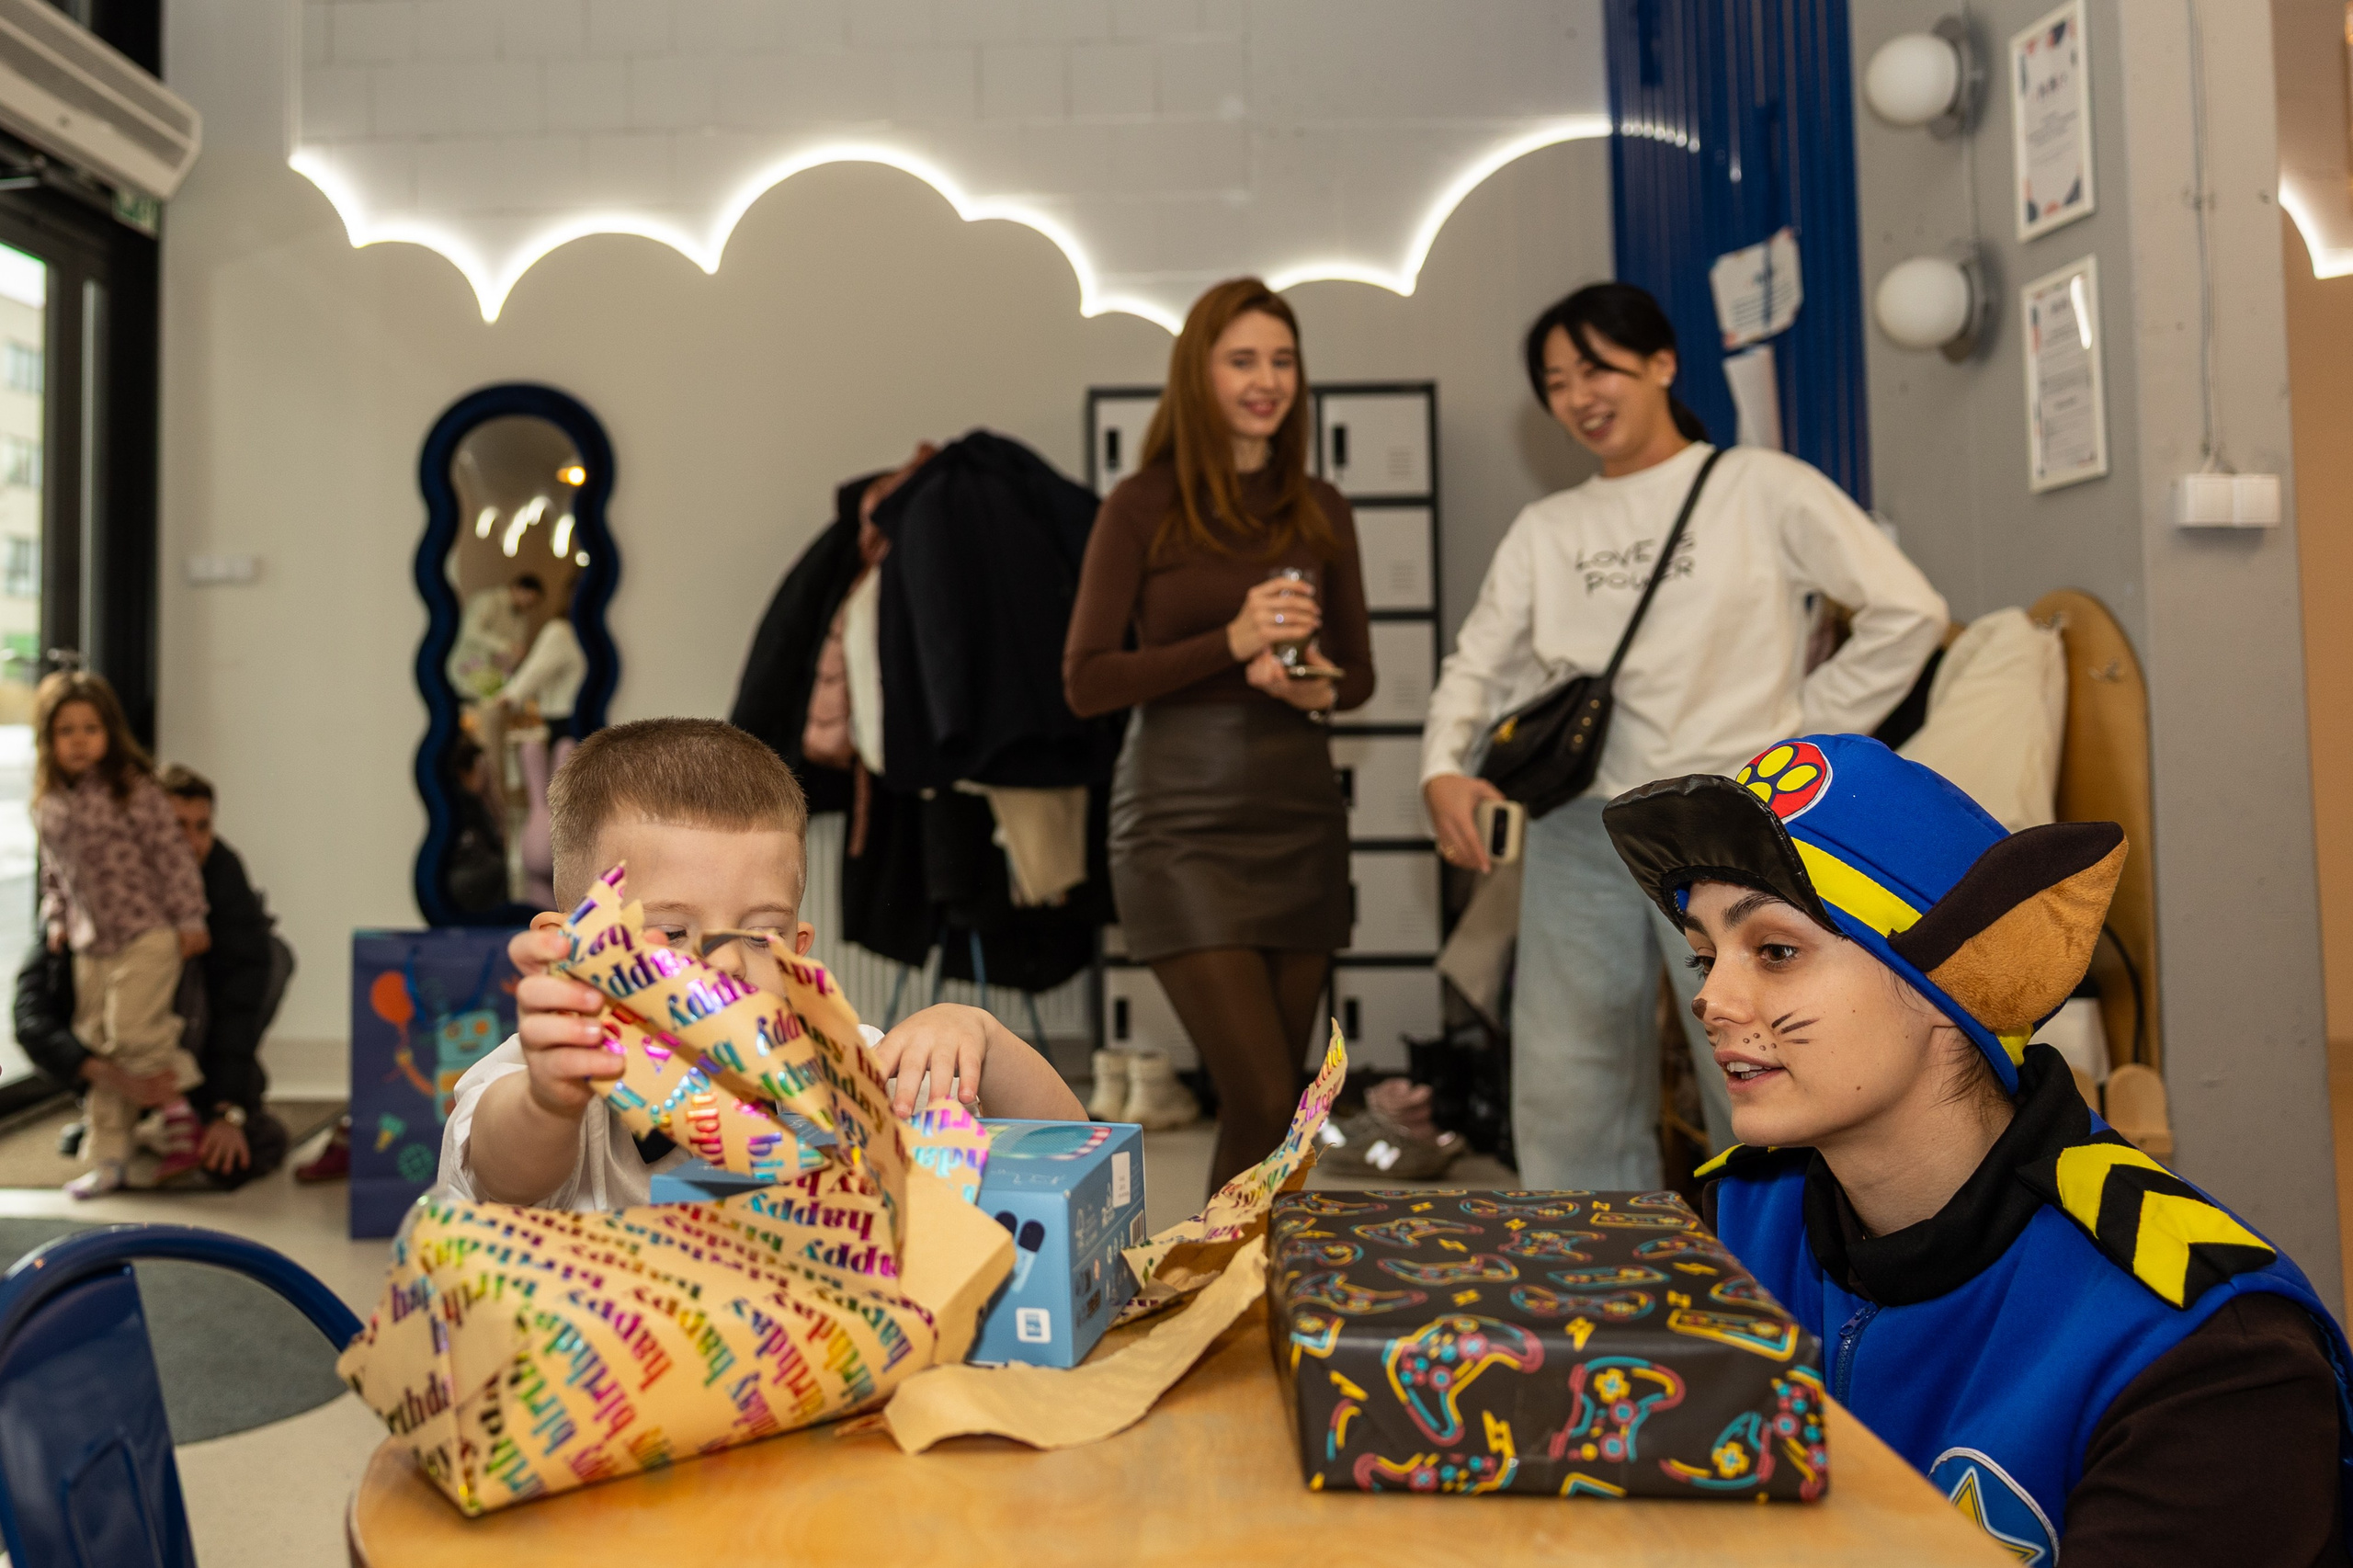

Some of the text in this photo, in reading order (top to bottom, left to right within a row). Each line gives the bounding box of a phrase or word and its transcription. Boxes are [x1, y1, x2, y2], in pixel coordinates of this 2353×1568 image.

[1574, 538, 1655, 572] LOVE
[742, 1191, 875, 1242] happy
[798, 1238, 899, 1279] appy
